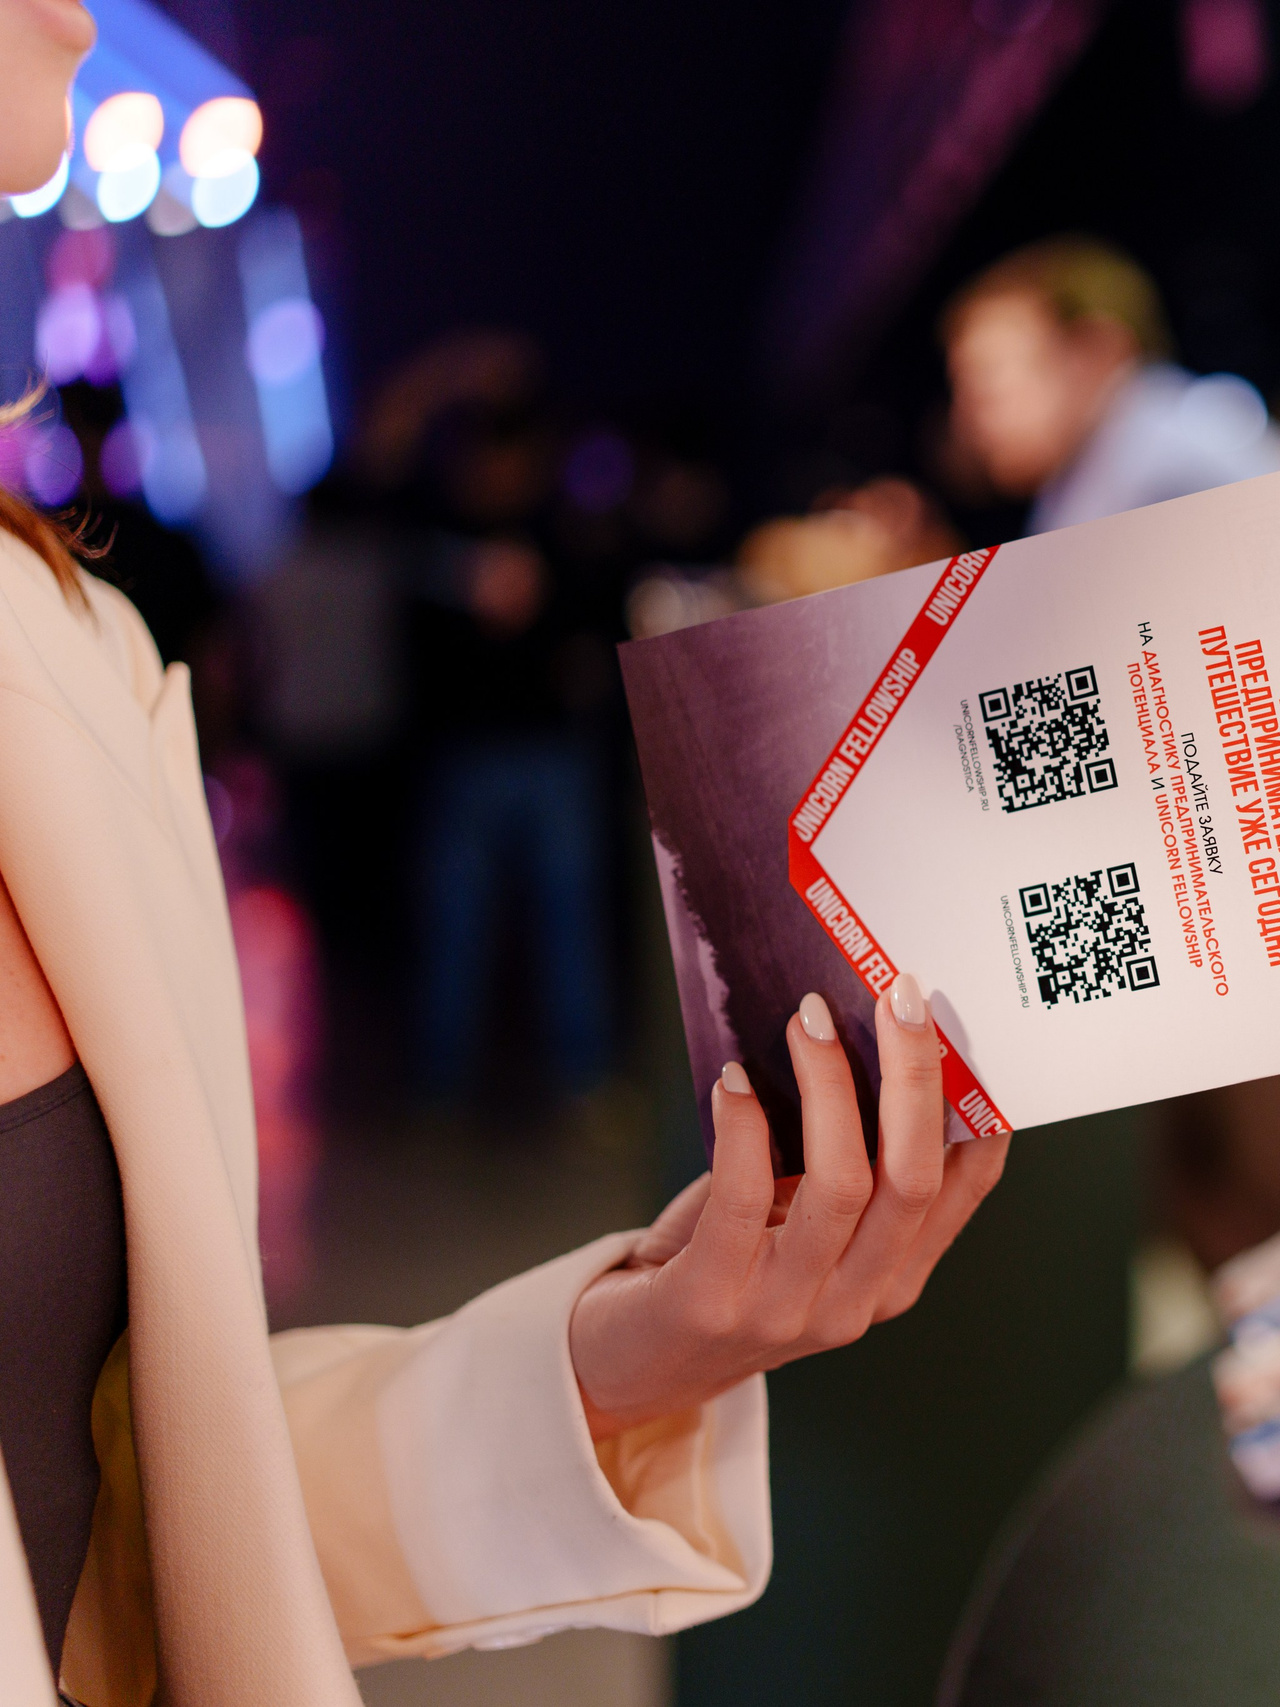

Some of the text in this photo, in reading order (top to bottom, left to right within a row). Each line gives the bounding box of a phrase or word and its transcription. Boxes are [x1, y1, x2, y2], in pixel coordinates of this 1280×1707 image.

[792, 648, 921, 843] UNICORN FELLOWSHIP
[953, 724, 975, 793] /DIAGNOSTICA
[960, 699, 990, 812] UNICORNFELLOWSHIP.RU
[1137, 621, 1229, 996] НА ДИАГНОСТИКУ ПРЕДПРИНИМАТЕЛЬСКОГО
[1181, 732, 1223, 874] ПОДАЙТЕ ЗАЯВКУ
[1198, 625, 1259, 797] ПУТЕШЕСТВИЕ
[1235, 798, 1272, 854] УЖЕ
[1127, 662, 1203, 968] ПОТЕНЦИАЛА И UNICORN FELLOWSHIP
[805, 877, 874, 962] UNICORN
[1000, 895, 1030, 1008] UNICORNFELLOWSHIP.RU
